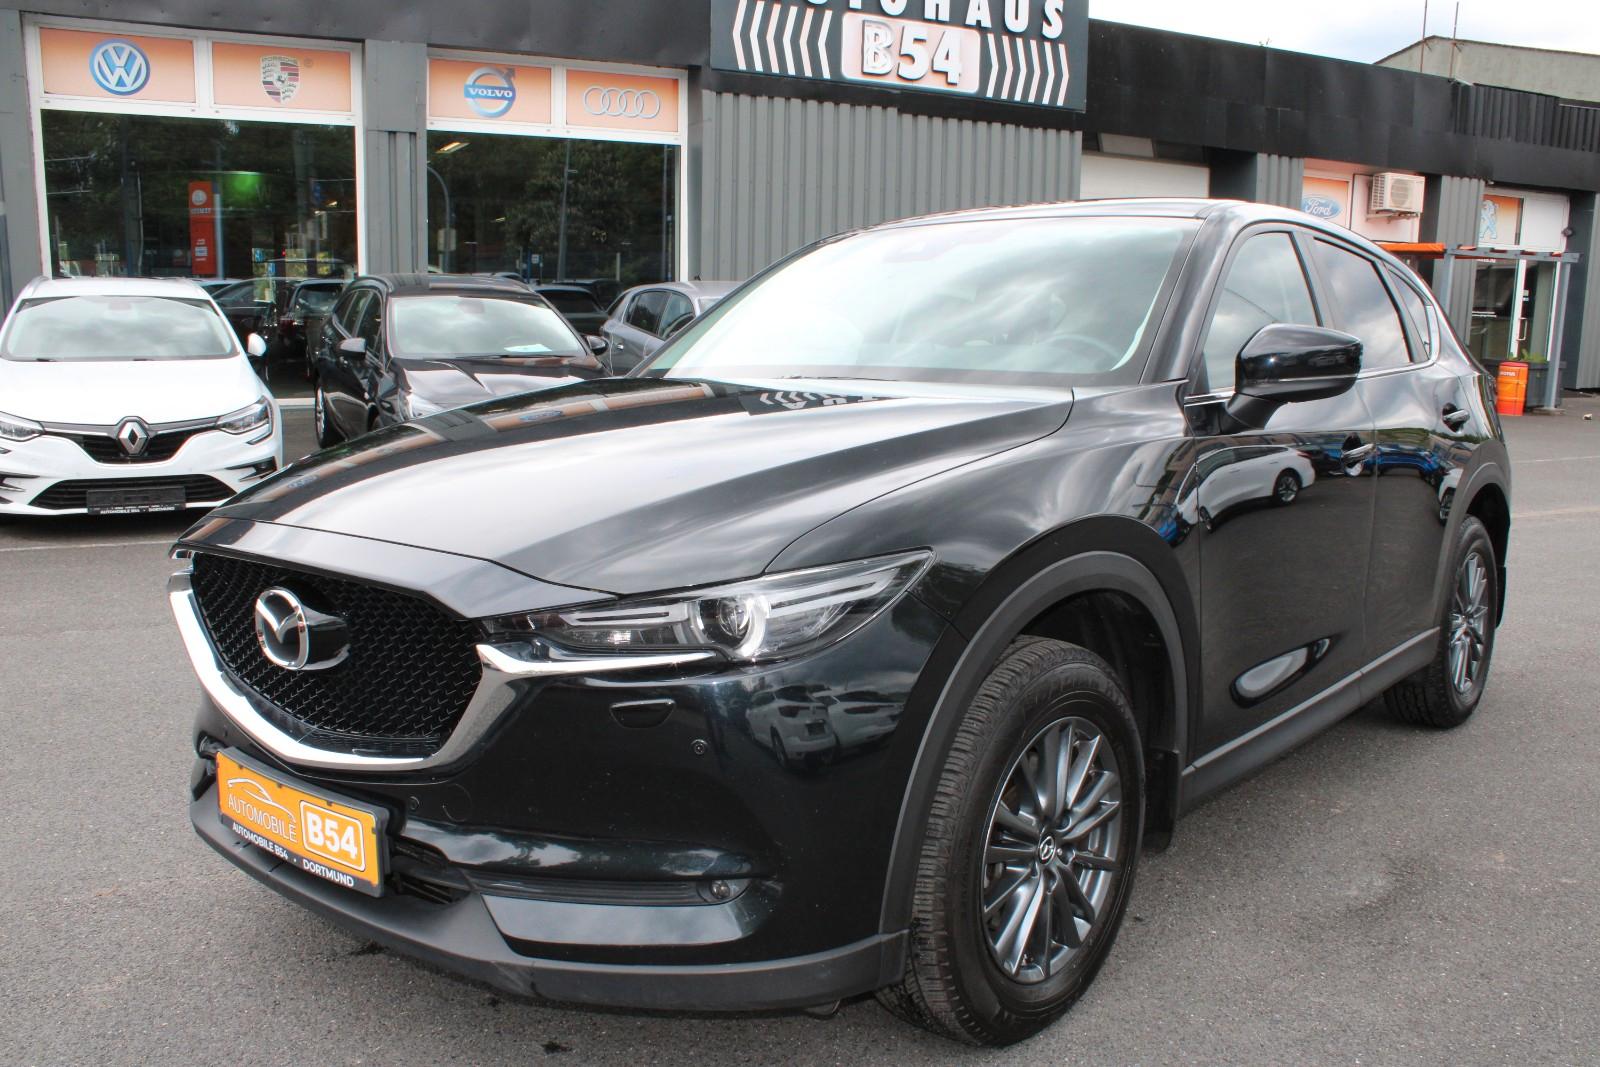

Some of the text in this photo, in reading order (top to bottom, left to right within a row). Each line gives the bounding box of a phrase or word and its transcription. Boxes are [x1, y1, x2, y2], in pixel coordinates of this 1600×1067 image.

[862, 20, 962, 86] B54
[468, 87, 513, 98] VOLVO
[1304, 198, 1332, 217] Ford
[227, 793, 299, 843] AUTOMOBILE
[306, 811, 359, 860] B54
[232, 821, 355, 888] AUTOMOBILE B54 DORTMUND
